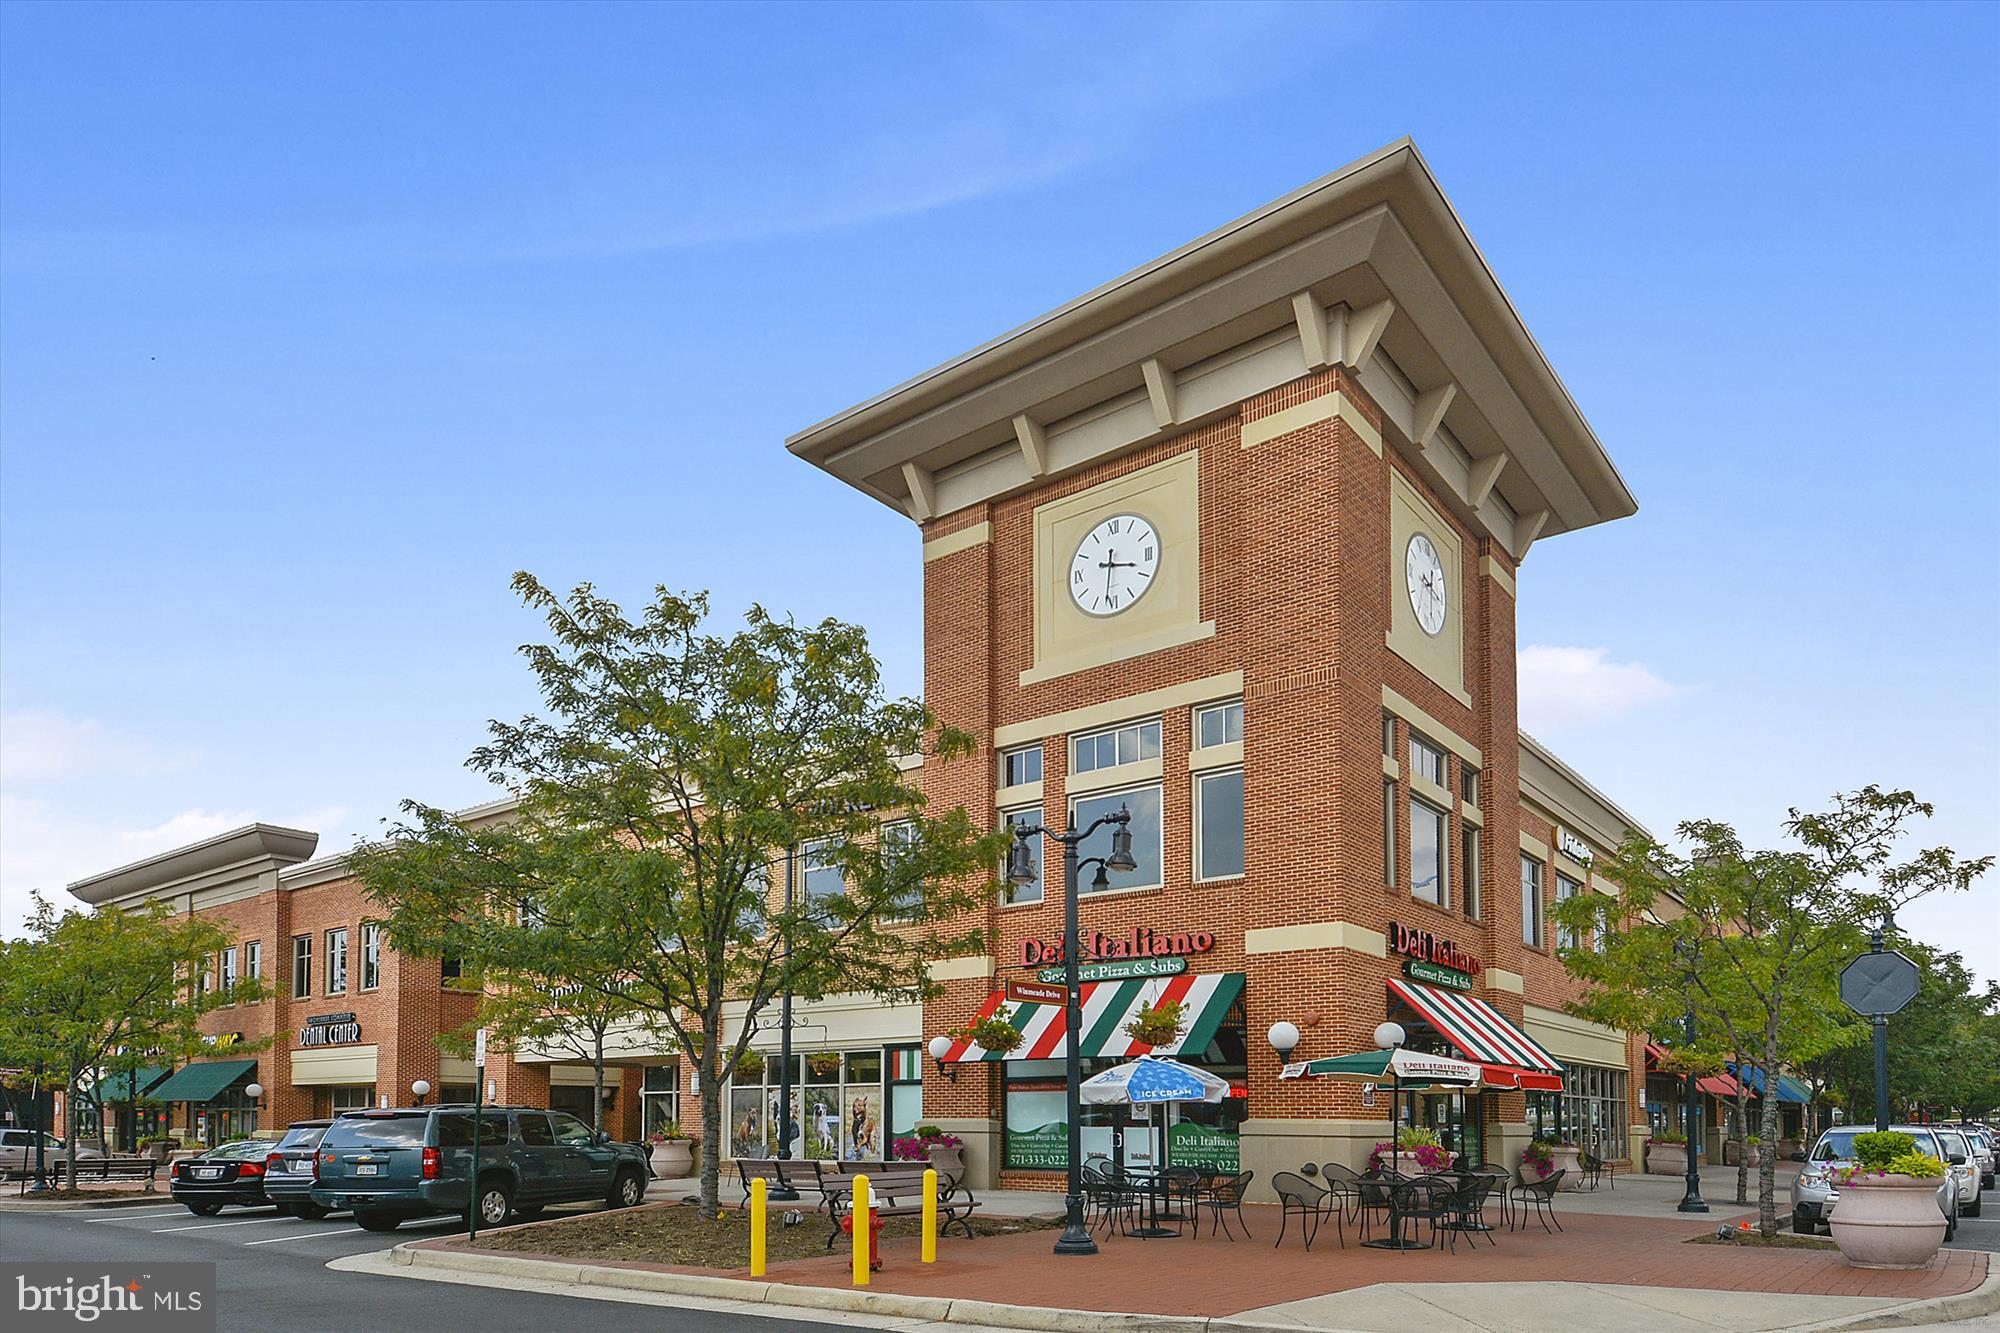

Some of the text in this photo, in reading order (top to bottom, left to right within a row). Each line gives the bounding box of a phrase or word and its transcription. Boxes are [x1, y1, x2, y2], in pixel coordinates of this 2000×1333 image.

[1018, 927, 1213, 966] Del Italiano
[1396, 922, 1481, 975] Deli Italiano
[1042, 959, 1181, 983] Goet Pizza & Subs
[1411, 963, 1471, 990] Gourmet Pizza & Subs
[1016, 986, 1061, 999] Winmeade Drive
[300, 1023, 358, 1046] DENTAL CENTER
[1141, 1088, 1192, 1098] ICE CREAM
[1230, 1088, 1248, 1098] PEN
[1176, 1135, 1240, 1147] Deli Italiano
